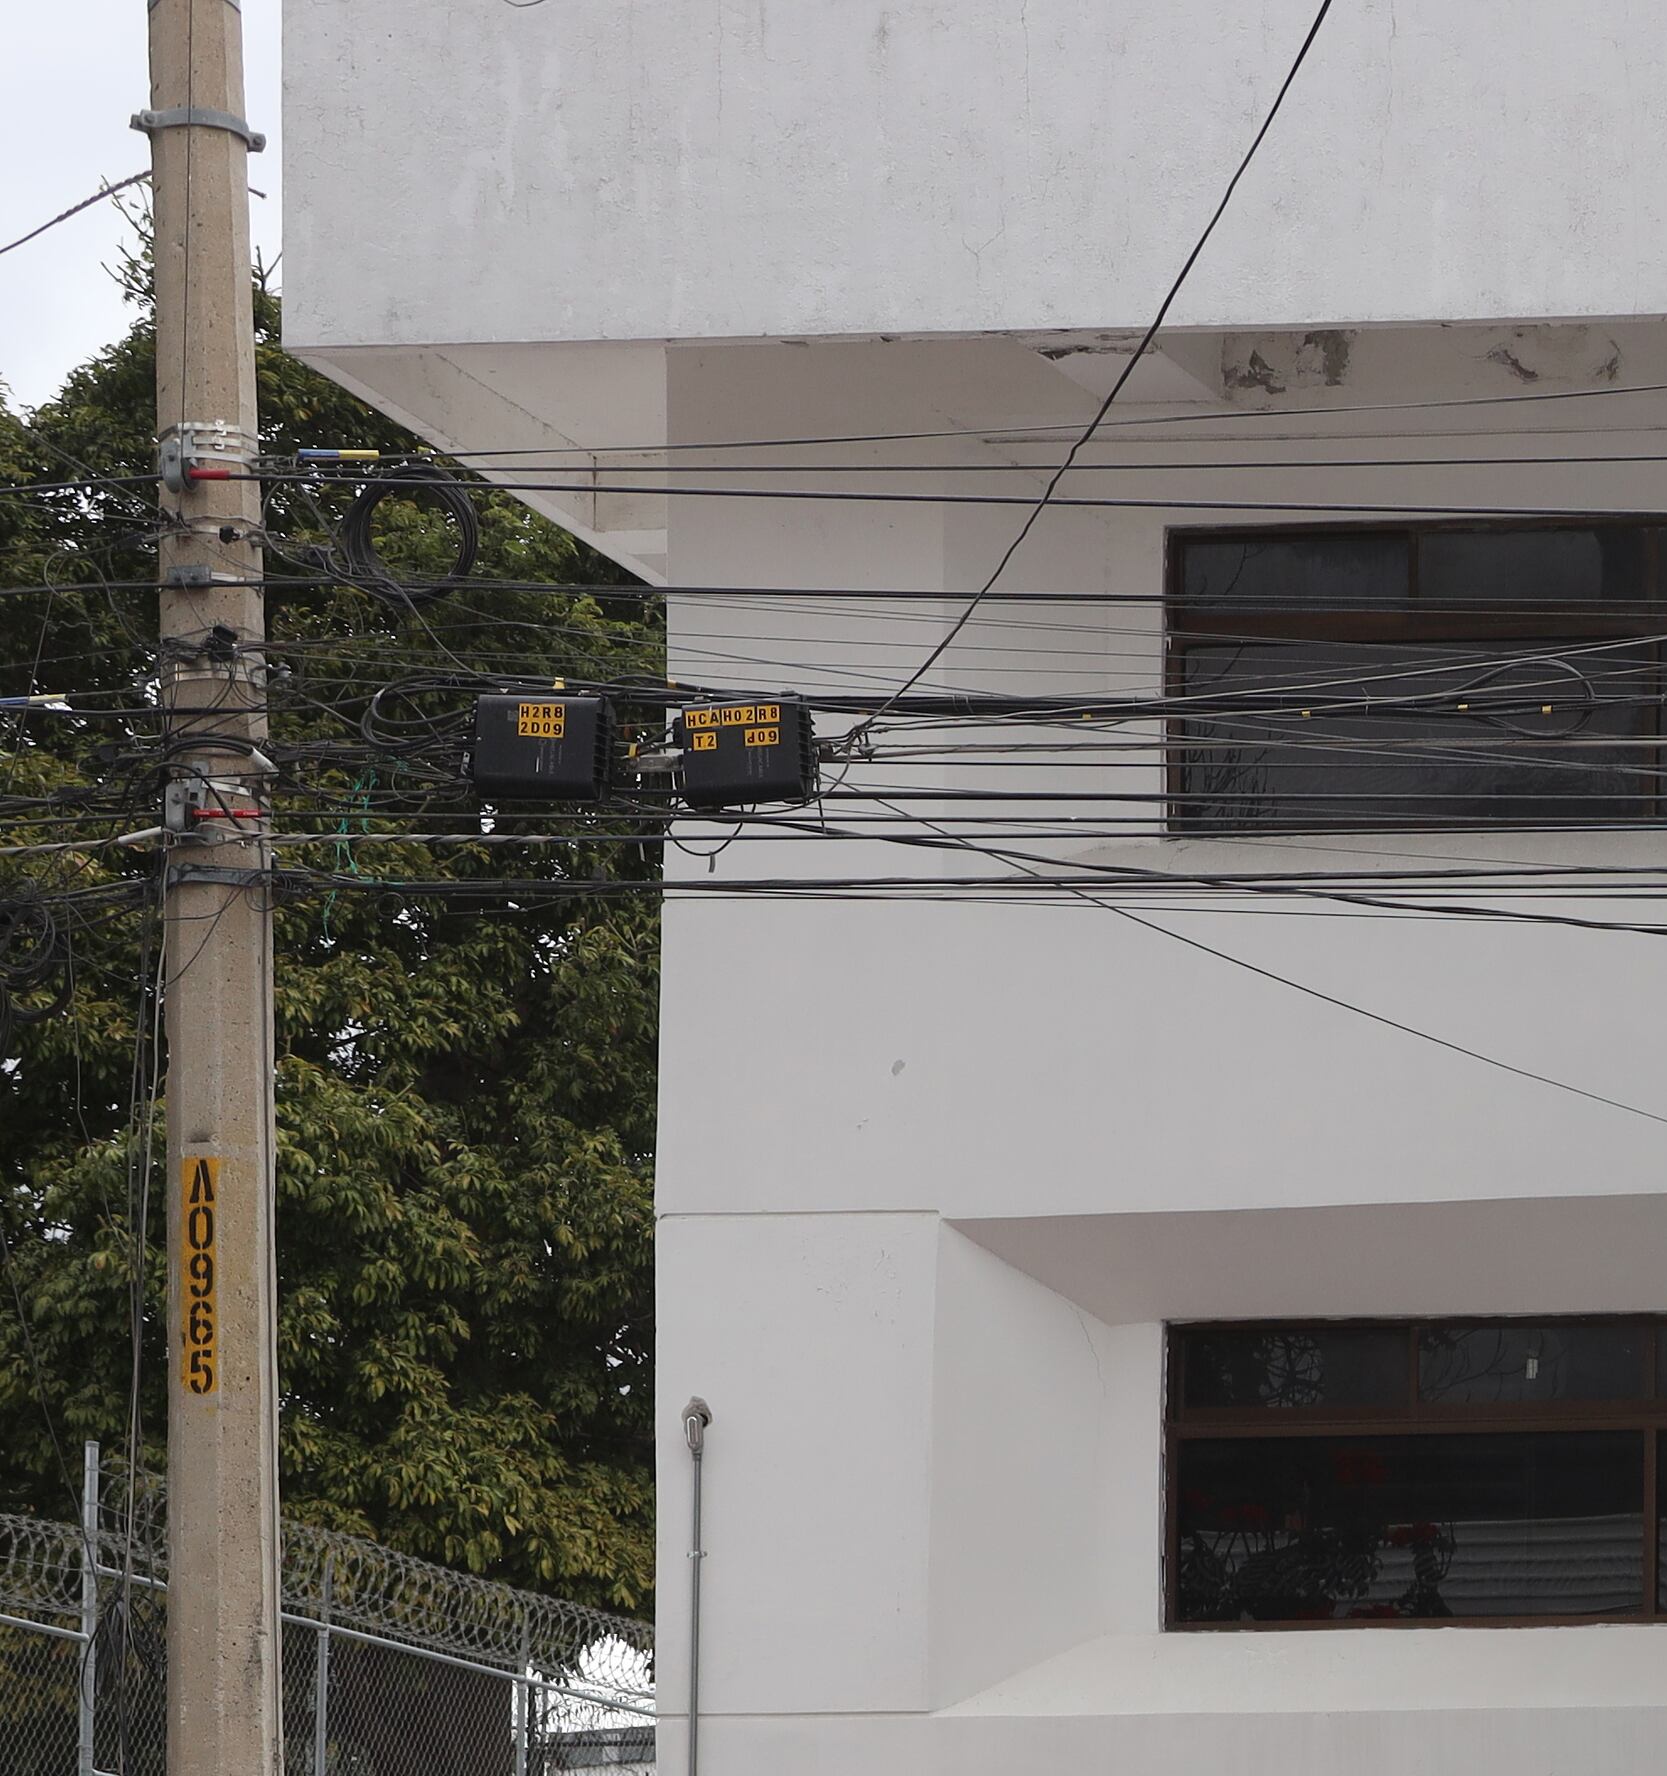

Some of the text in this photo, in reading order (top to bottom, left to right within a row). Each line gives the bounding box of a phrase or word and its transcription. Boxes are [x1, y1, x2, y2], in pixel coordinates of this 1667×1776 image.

[520, 705, 563, 719] H2R8
[687, 712, 719, 727] HCA
[758, 706, 778, 720] R8
[520, 721, 562, 735] 2D09
[695, 735, 715, 748] T2
